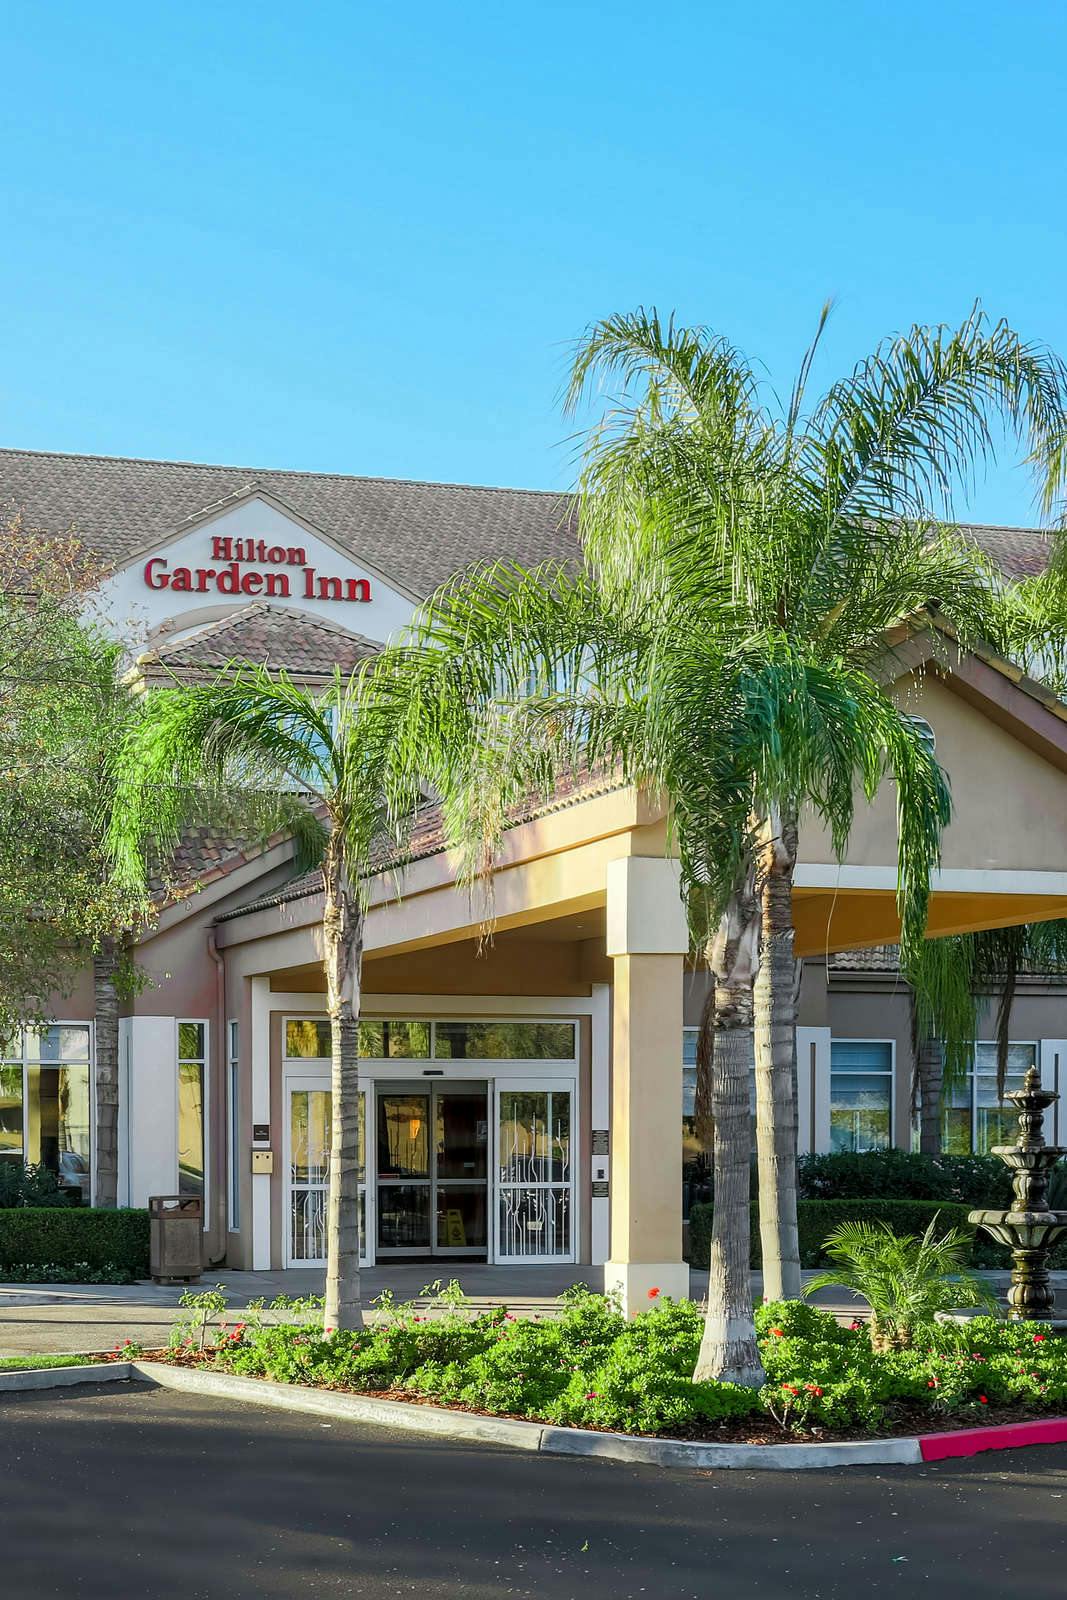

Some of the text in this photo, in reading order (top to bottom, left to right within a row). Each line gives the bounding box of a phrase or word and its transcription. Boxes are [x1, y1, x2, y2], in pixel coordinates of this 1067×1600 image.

[211, 536, 307, 566] Hilton
[144, 558, 373, 602] Garden Inn
